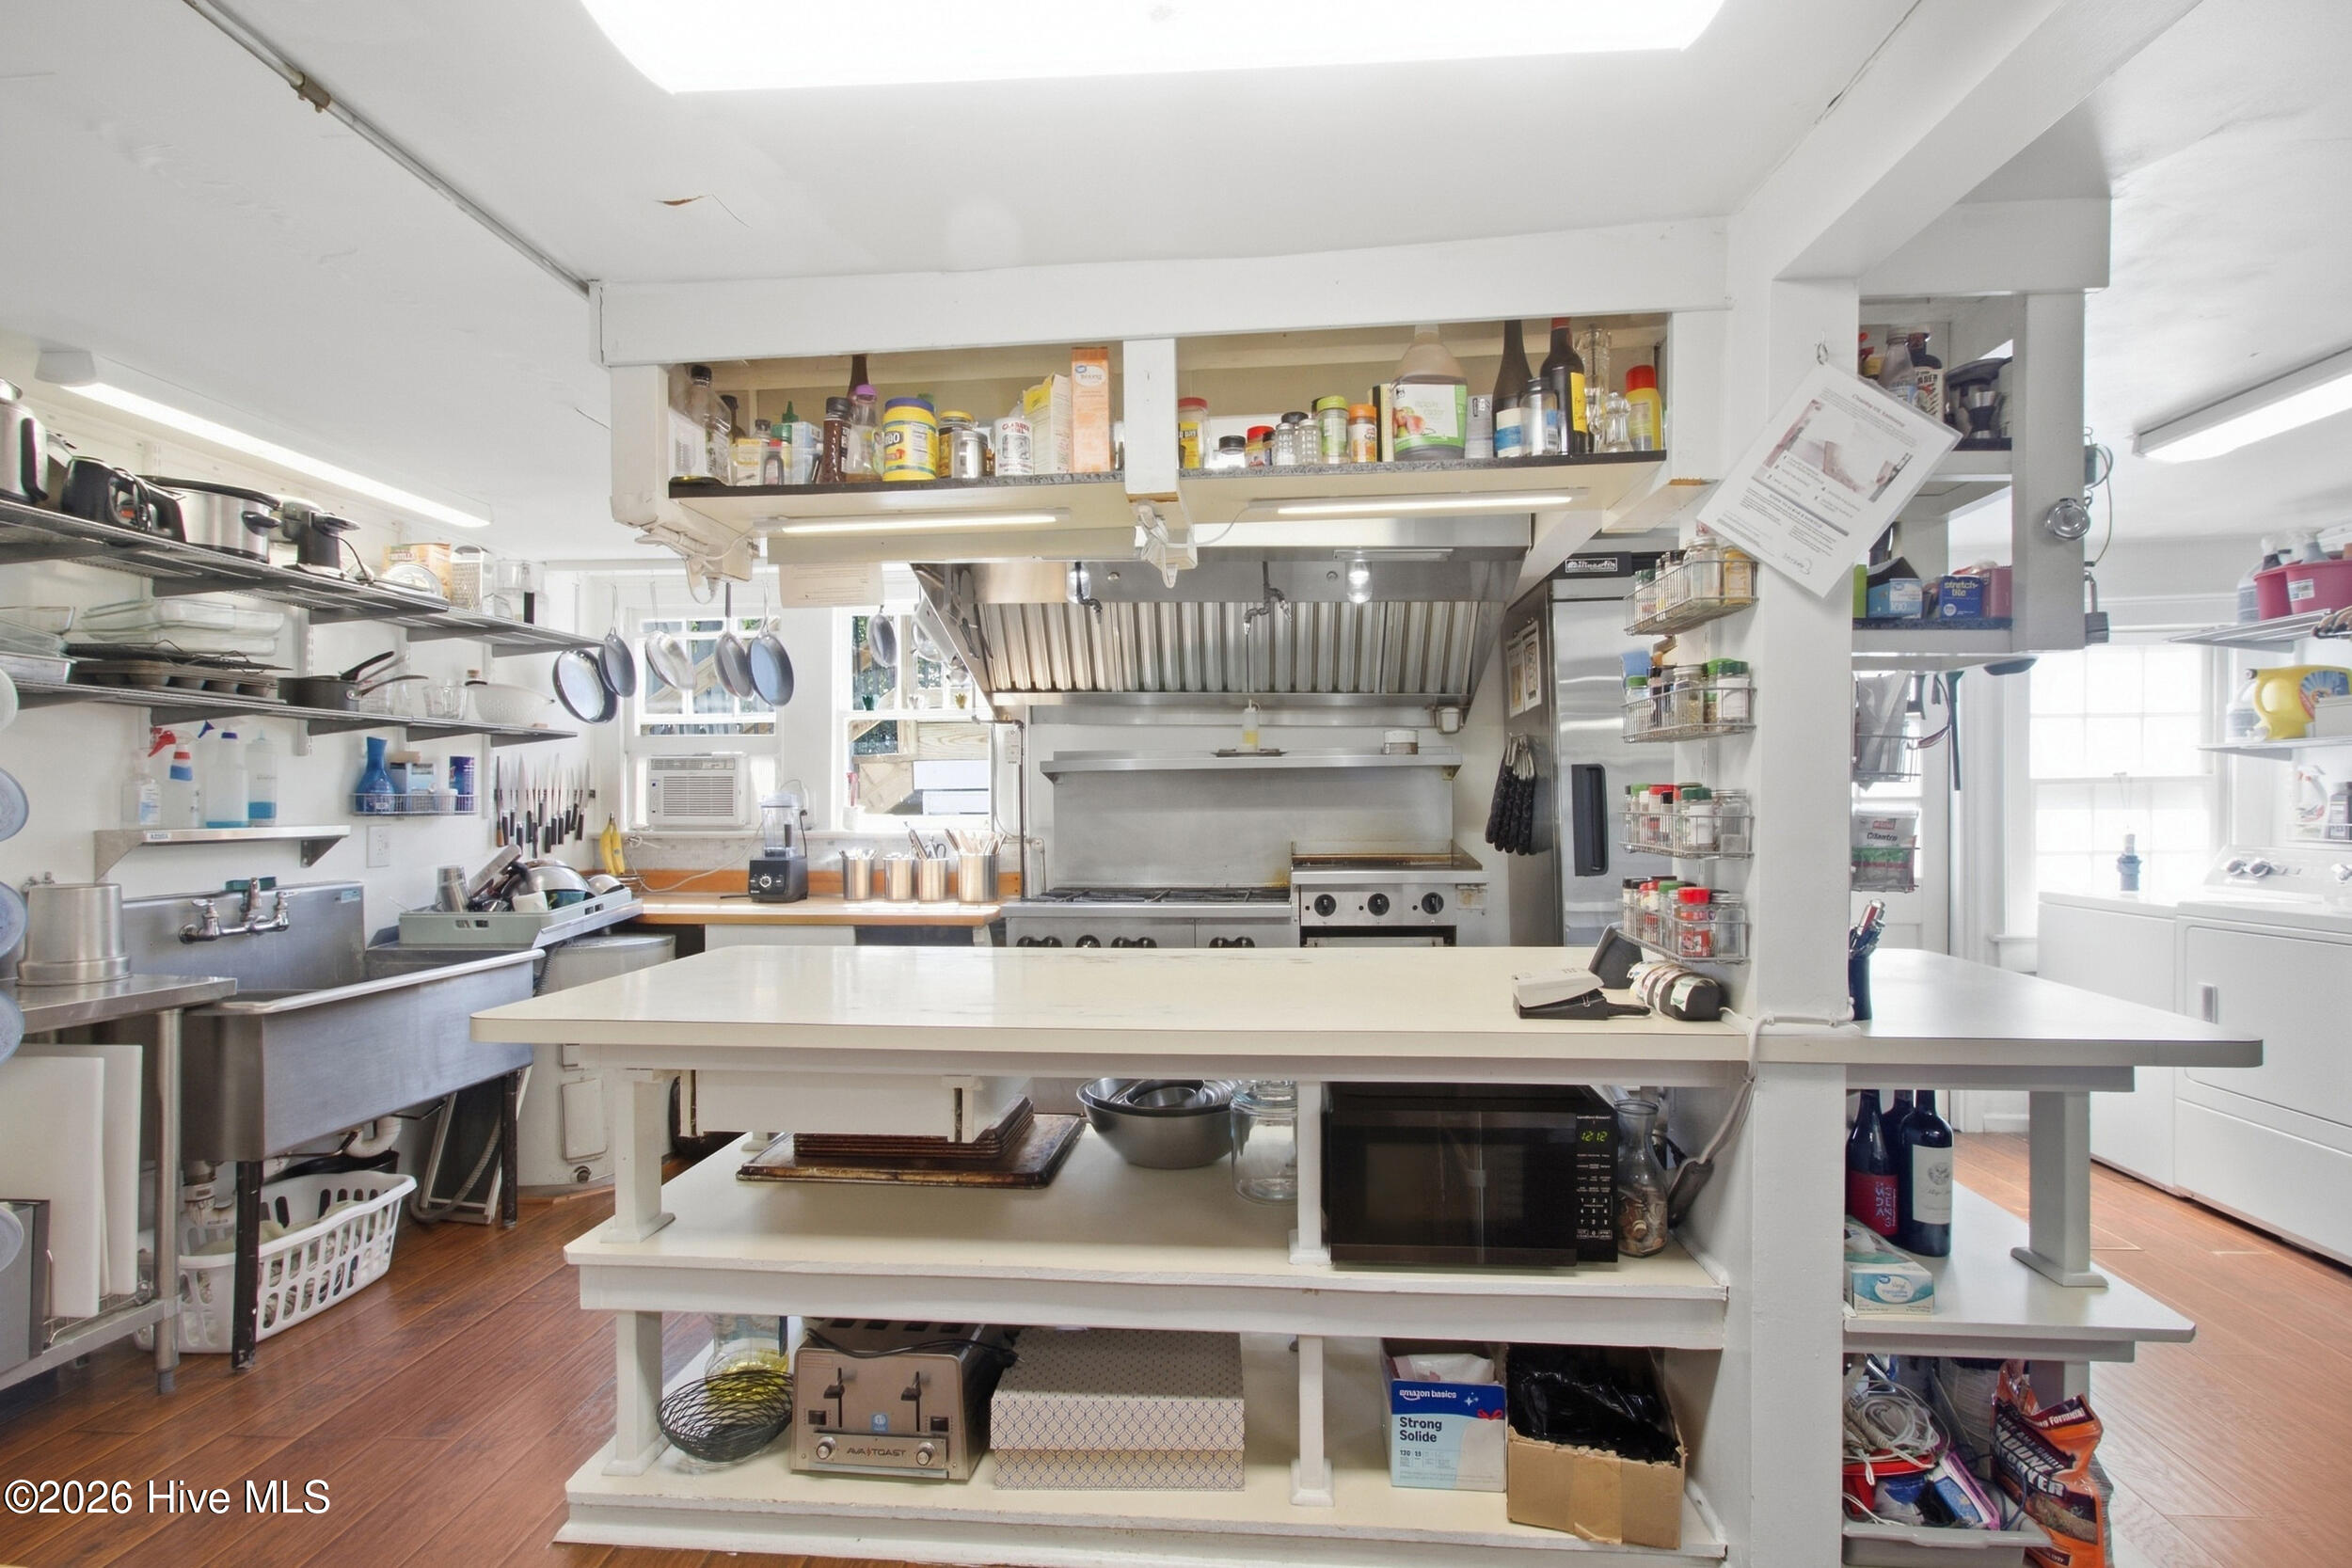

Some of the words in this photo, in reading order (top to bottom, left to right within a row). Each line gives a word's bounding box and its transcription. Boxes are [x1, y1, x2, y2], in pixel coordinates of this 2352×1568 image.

[1399, 1389, 1430, 1399] amazon
[1431, 1389, 1457, 1399] basics
[1399, 1417, 1442, 1431] Strong
[1399, 1430, 1438, 1443] Solide
